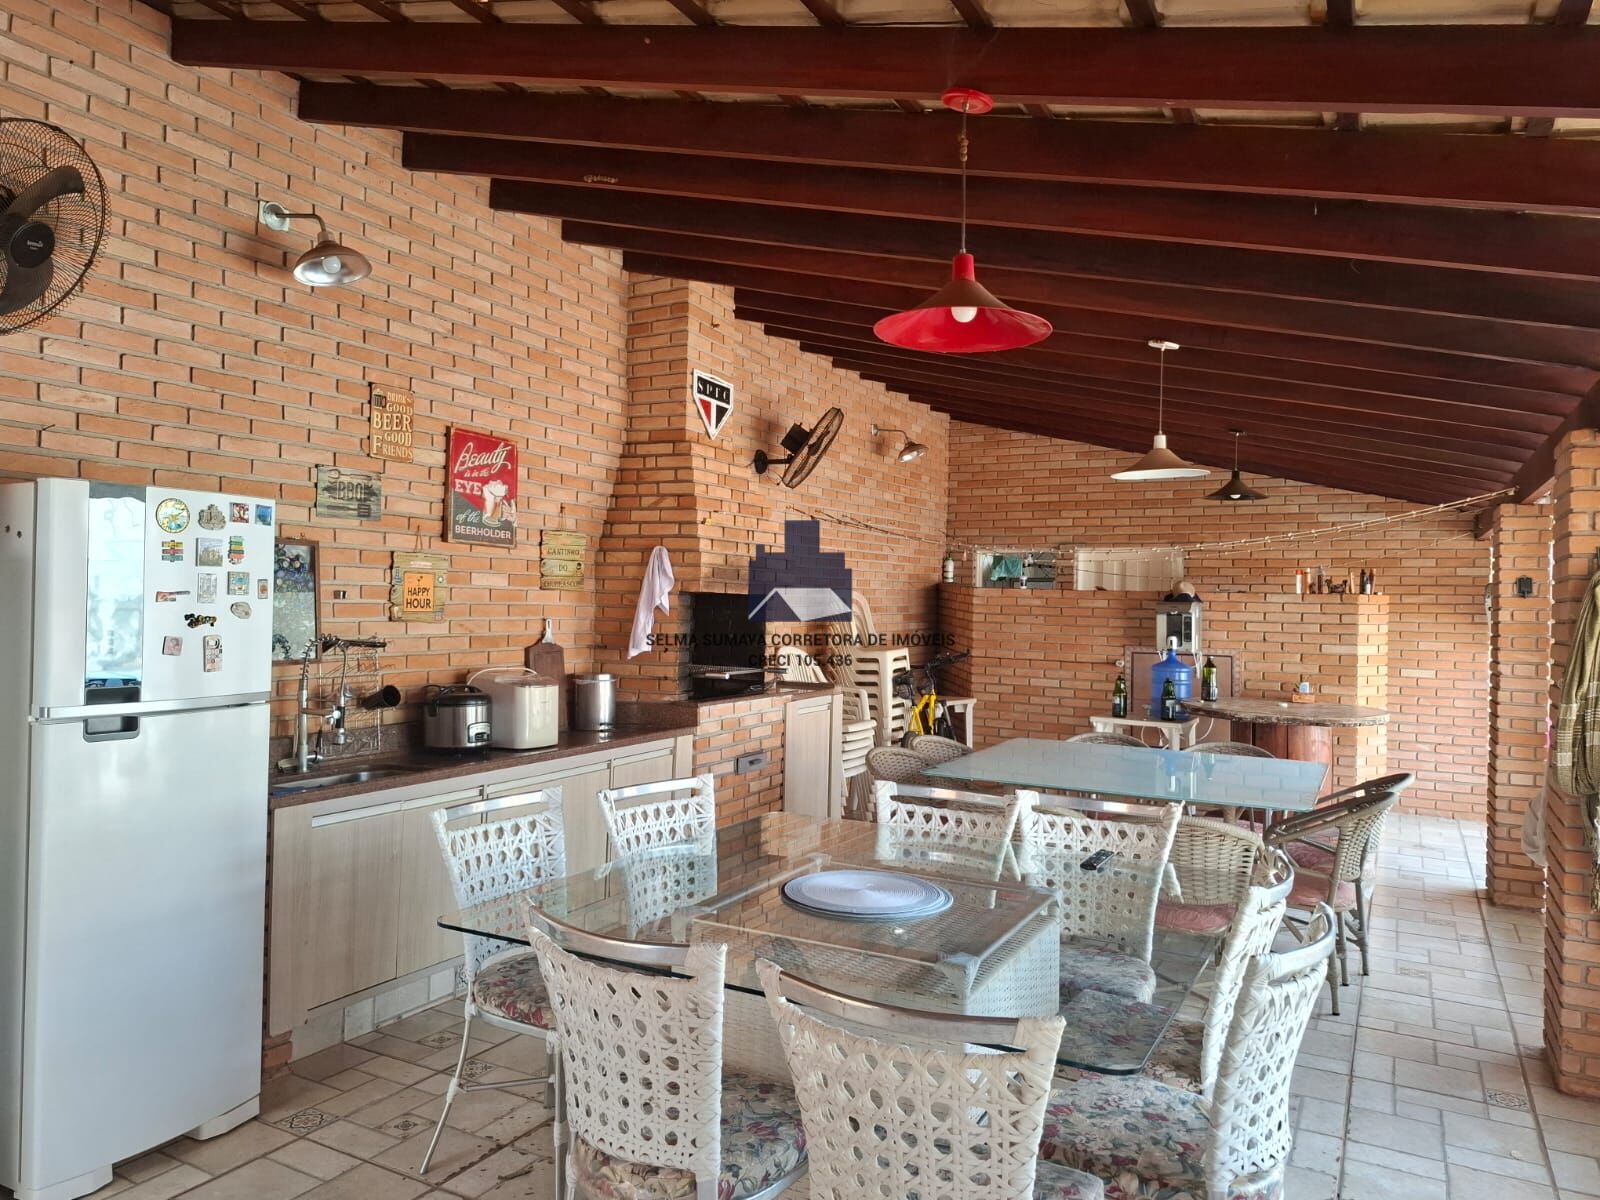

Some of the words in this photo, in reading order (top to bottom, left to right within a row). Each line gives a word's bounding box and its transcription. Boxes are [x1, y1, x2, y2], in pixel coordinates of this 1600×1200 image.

[386, 402, 412, 415] GOOD
[373, 411, 412, 432] BEER
[384, 431, 412, 446] GOOD
[373, 435, 413, 458] FRIENDS
[454, 442, 512, 473] Beauty
[455, 479, 481, 494] EYE
[456, 509, 470, 523] of
[468, 510, 480, 523] the
[455, 525, 511, 539] BEERHOLDER
[407, 587, 430, 596] HAPPY
[406, 598, 431, 608] HOUR
